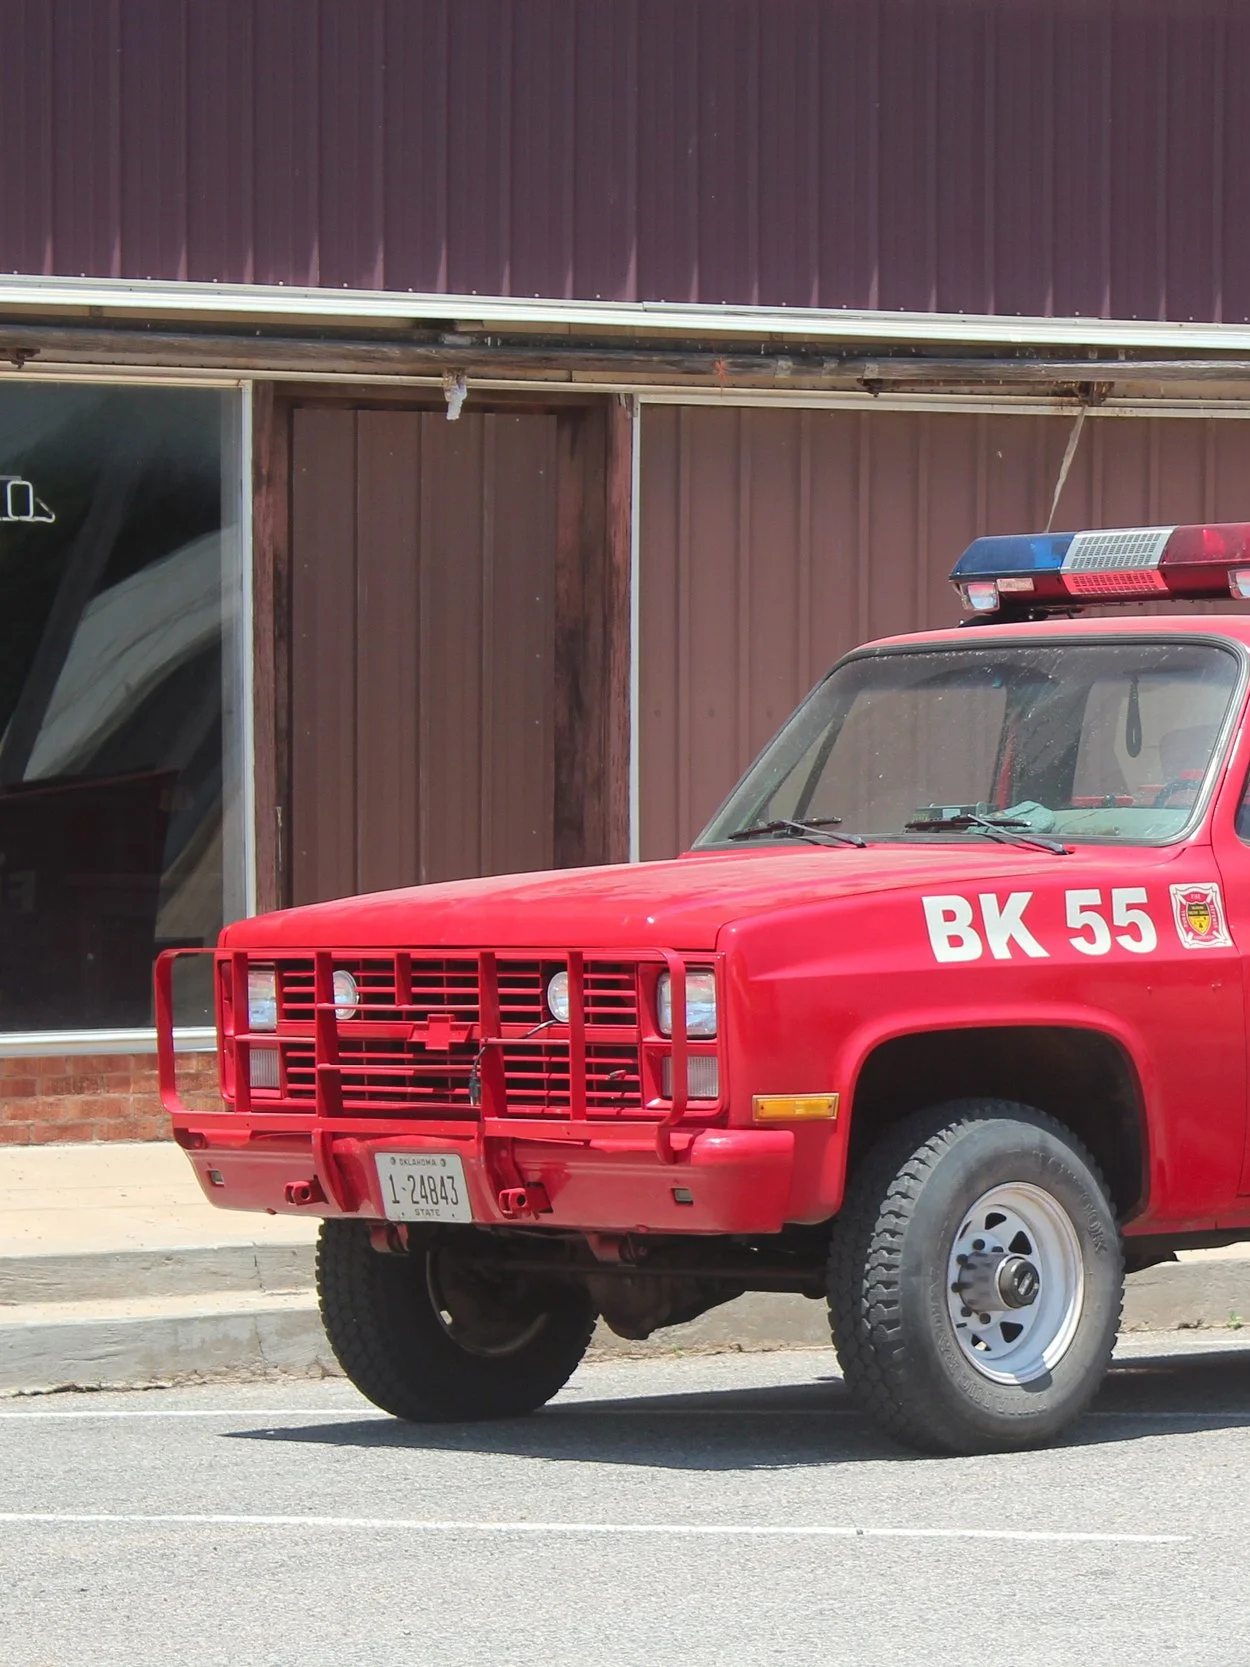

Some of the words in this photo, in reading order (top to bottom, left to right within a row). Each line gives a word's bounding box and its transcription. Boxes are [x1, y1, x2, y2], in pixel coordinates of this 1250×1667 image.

[921, 891, 1050, 962] BK
[1065, 887, 1157, 955] 55
[399, 1158, 437, 1167] OKLAHOMA
[388, 1174, 459, 1206] 1-24843
[414, 1208, 440, 1217] STATE
